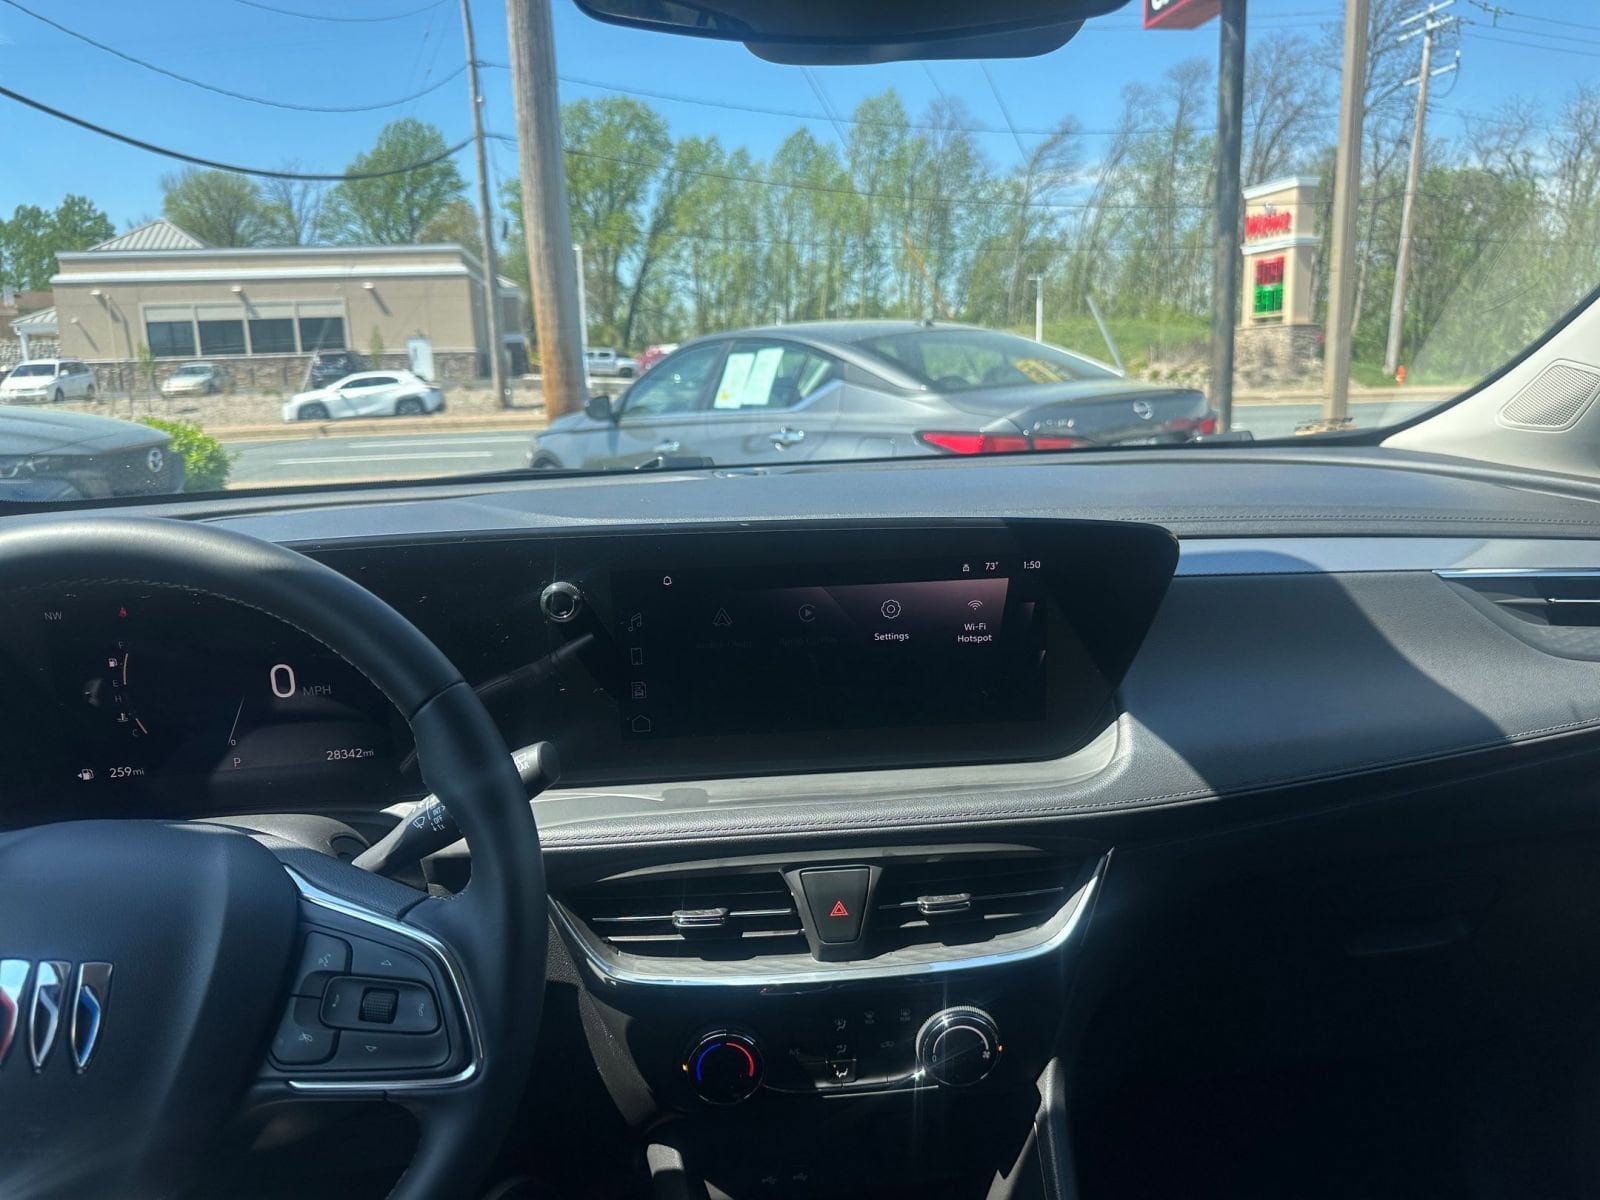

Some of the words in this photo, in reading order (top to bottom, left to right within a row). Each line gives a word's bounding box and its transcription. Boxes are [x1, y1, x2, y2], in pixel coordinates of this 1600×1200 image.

[1023, 560, 1041, 570] 1:50
[44, 611, 62, 621] NW
[963, 622, 986, 631] Wi-Fi
[873, 632, 910, 642] Settings
[957, 634, 993, 644] Hotspot
[112, 679, 119, 688] E
[270, 663, 296, 698] 0
[302, 685, 332, 697] MPH
[114, 695, 122, 703] H
[233, 757, 241, 768] P
